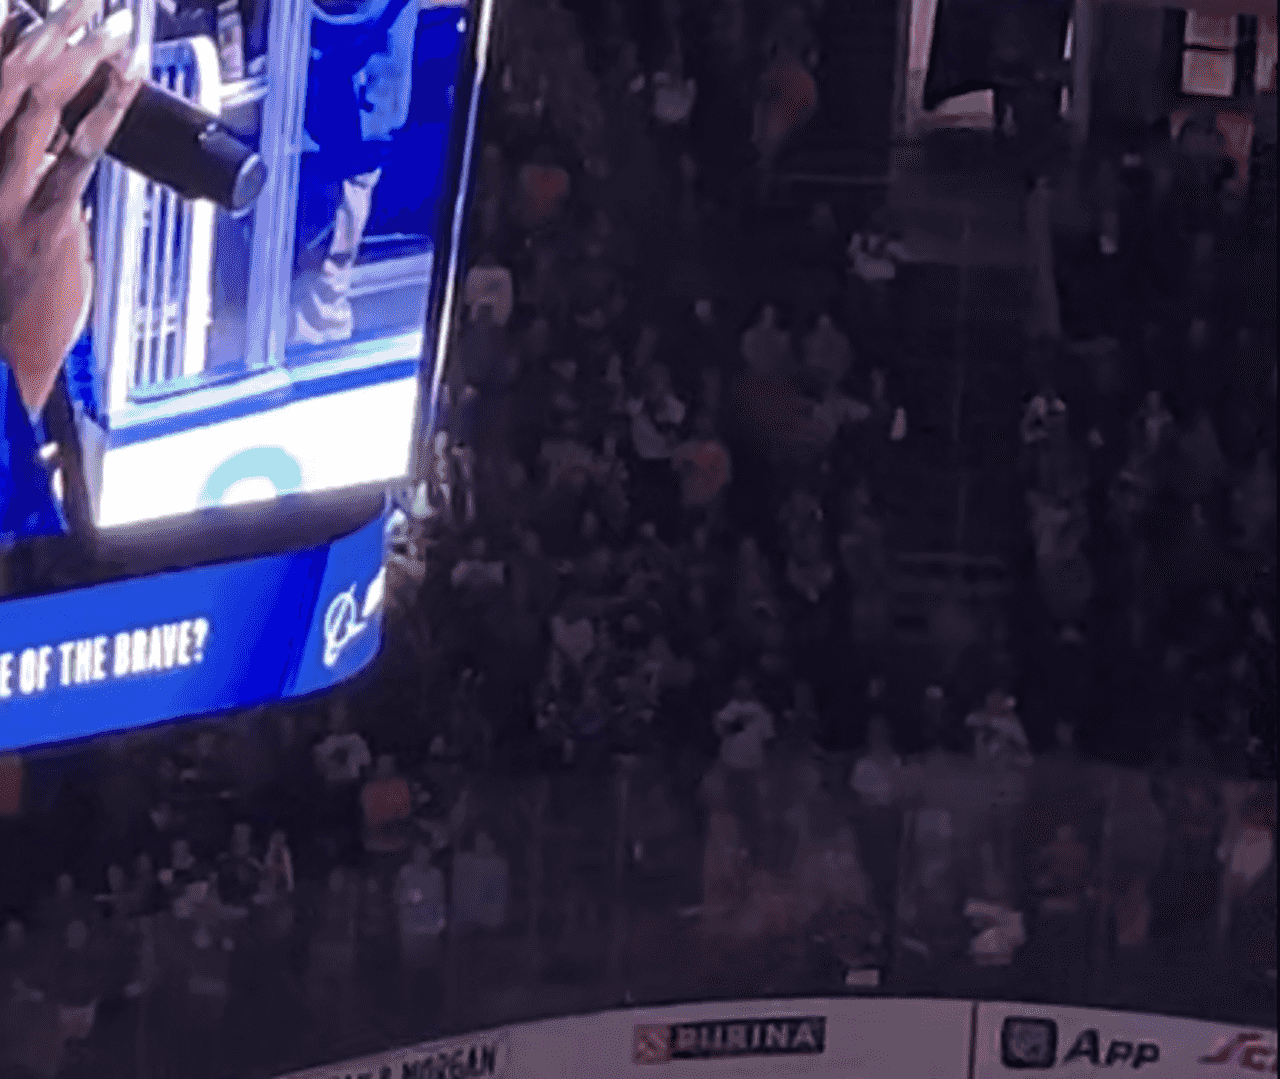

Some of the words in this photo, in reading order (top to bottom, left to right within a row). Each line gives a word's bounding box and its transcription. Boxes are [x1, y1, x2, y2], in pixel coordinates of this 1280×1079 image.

[19, 644, 52, 695] OF
[58, 635, 107, 687] THE
[113, 616, 210, 677] BRAVE?
